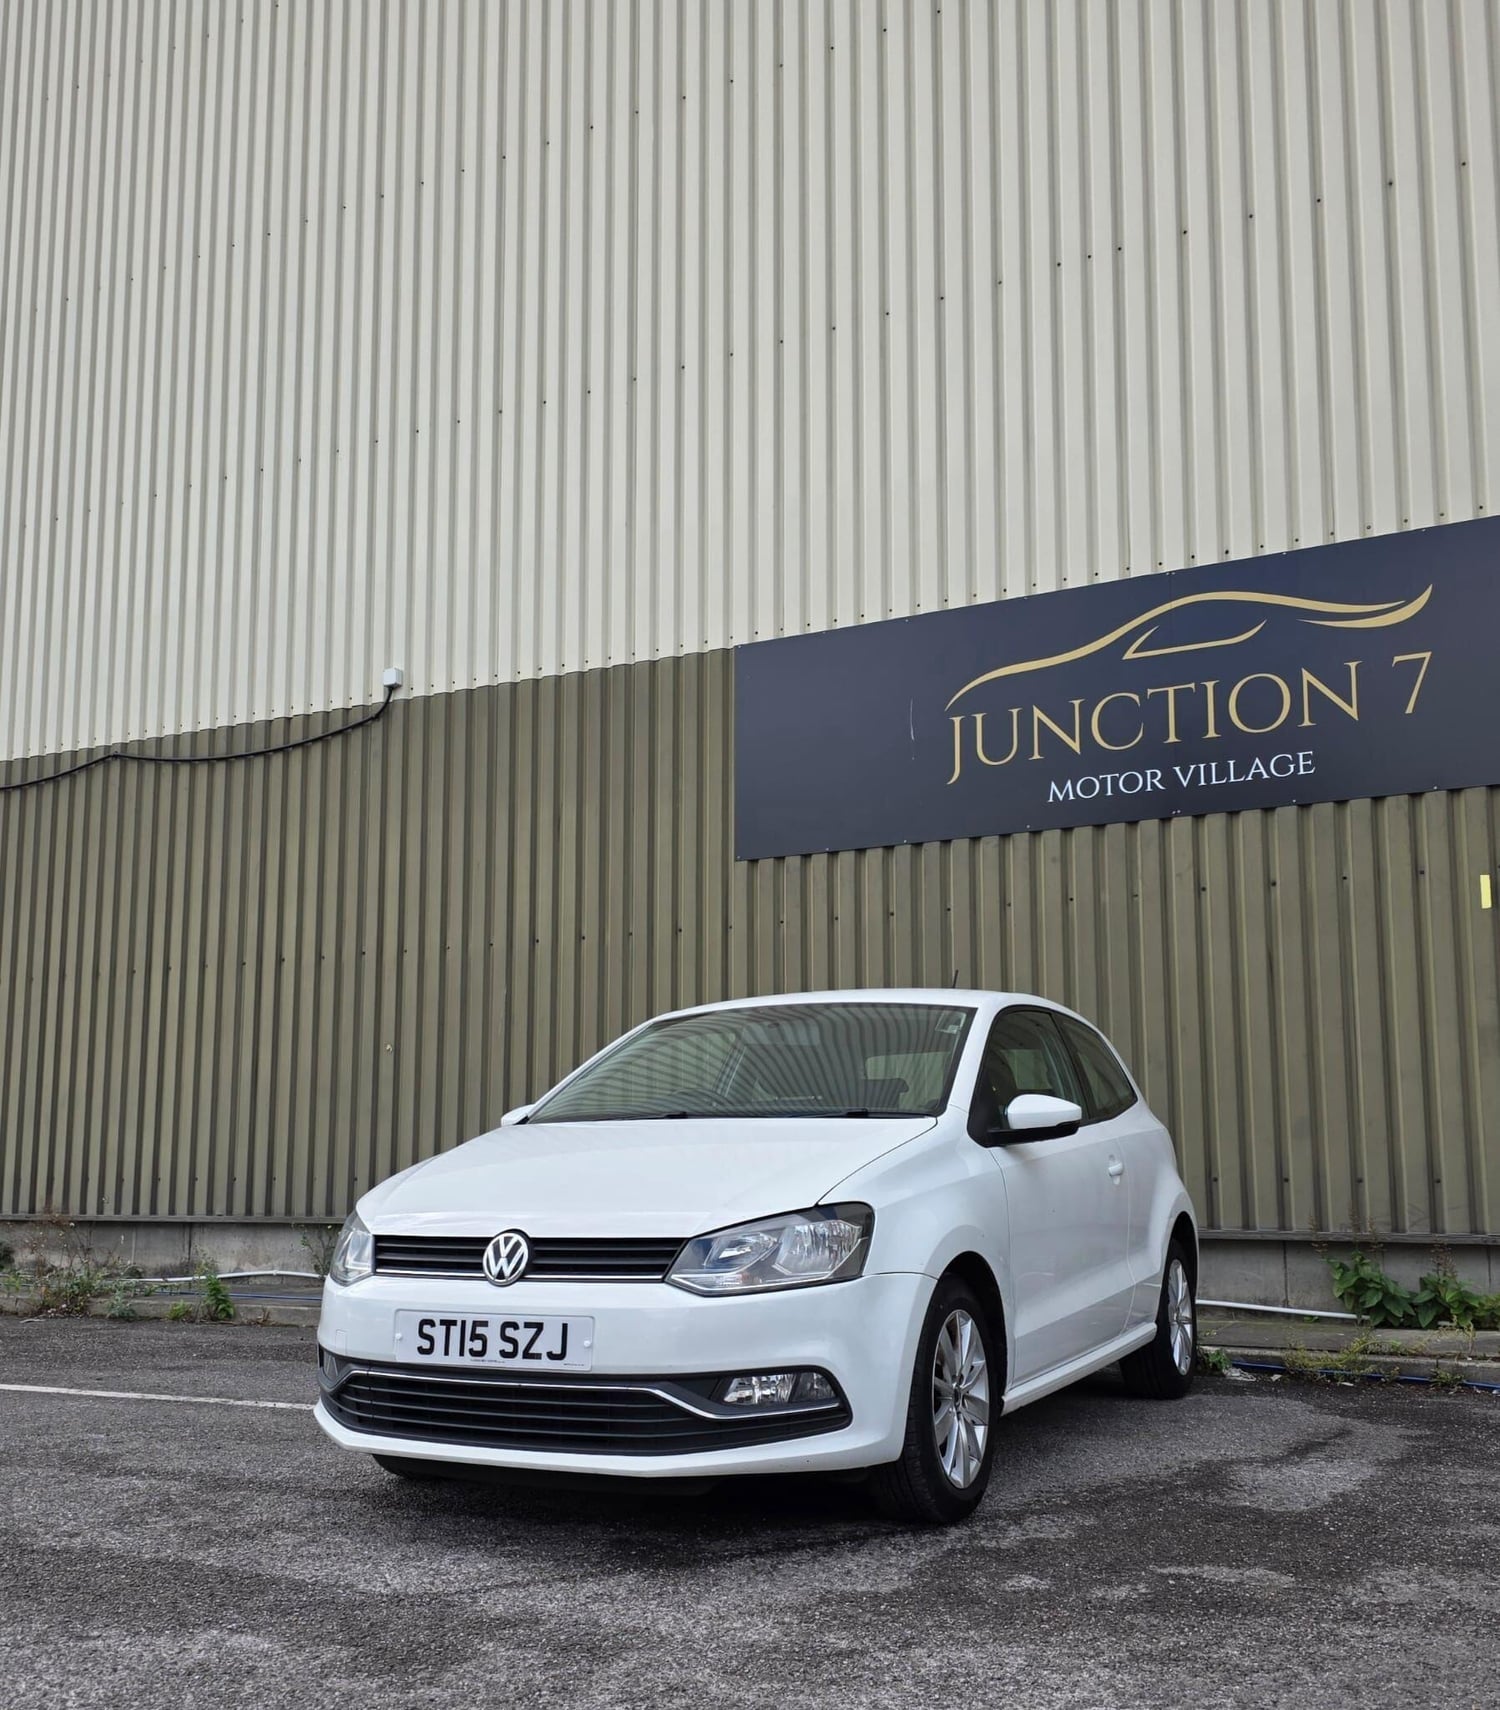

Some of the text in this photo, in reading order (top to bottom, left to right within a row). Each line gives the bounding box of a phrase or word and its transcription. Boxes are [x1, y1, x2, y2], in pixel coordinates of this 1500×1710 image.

[947, 651, 1433, 785] JUNCTION 7
[1048, 751, 1316, 803] MOTOR VILLAGE
[417, 1318, 568, 1361] ST15 SZJ
